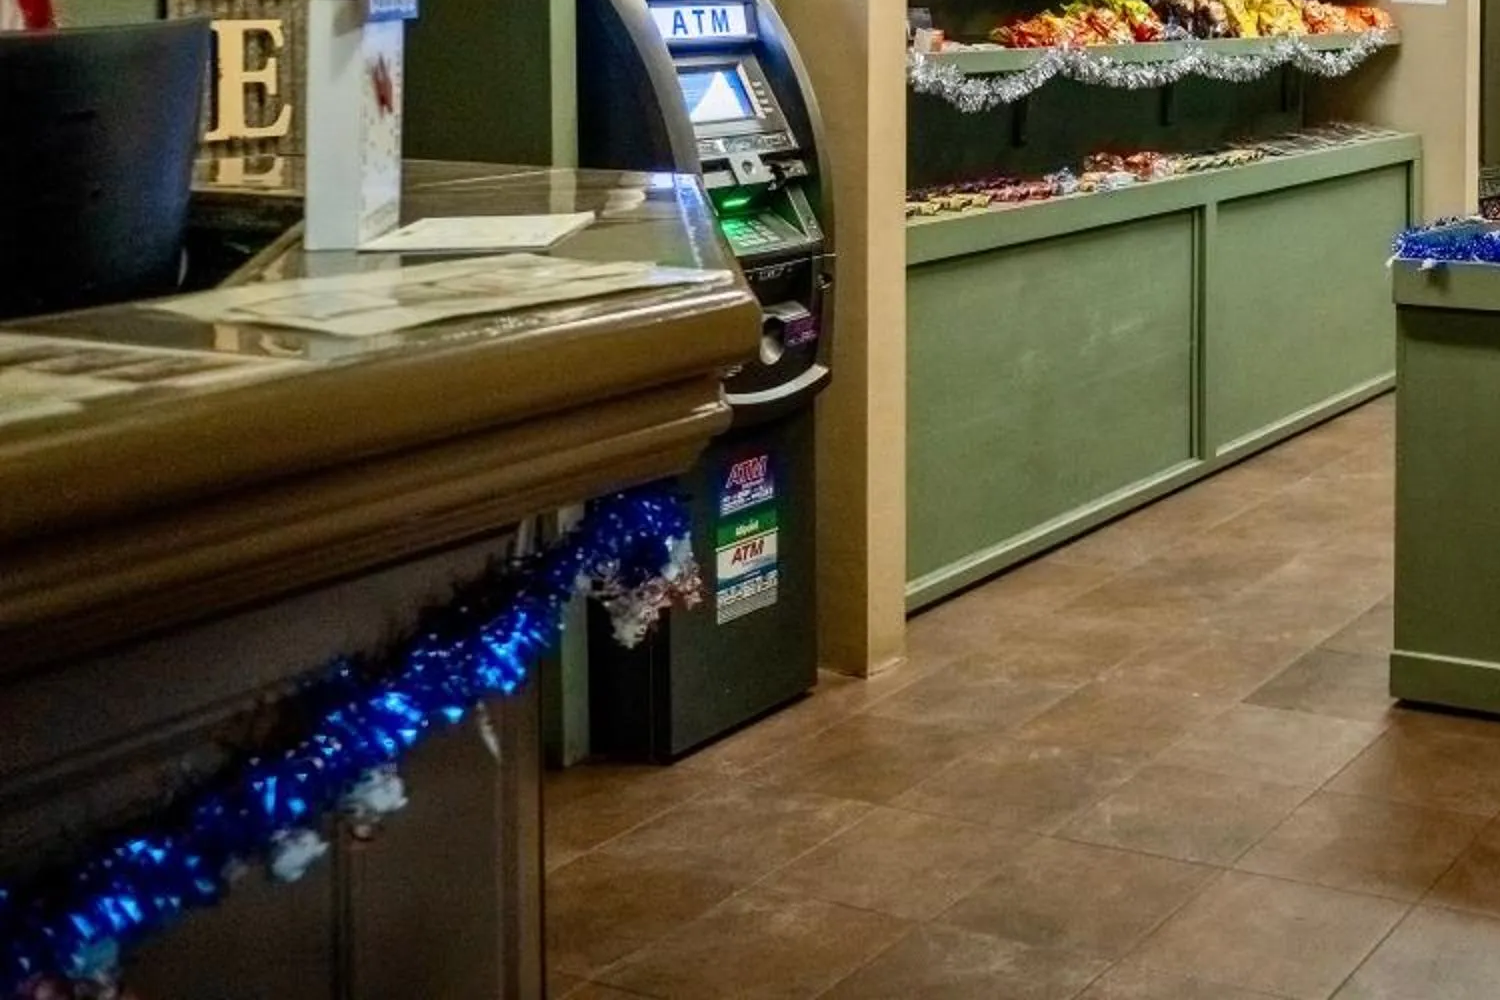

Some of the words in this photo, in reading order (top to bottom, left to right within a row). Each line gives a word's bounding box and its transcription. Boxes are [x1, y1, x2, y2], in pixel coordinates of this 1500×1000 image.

[672, 8, 730, 36] ATM
[725, 455, 768, 488] ATM
[732, 540, 764, 564] ATM
